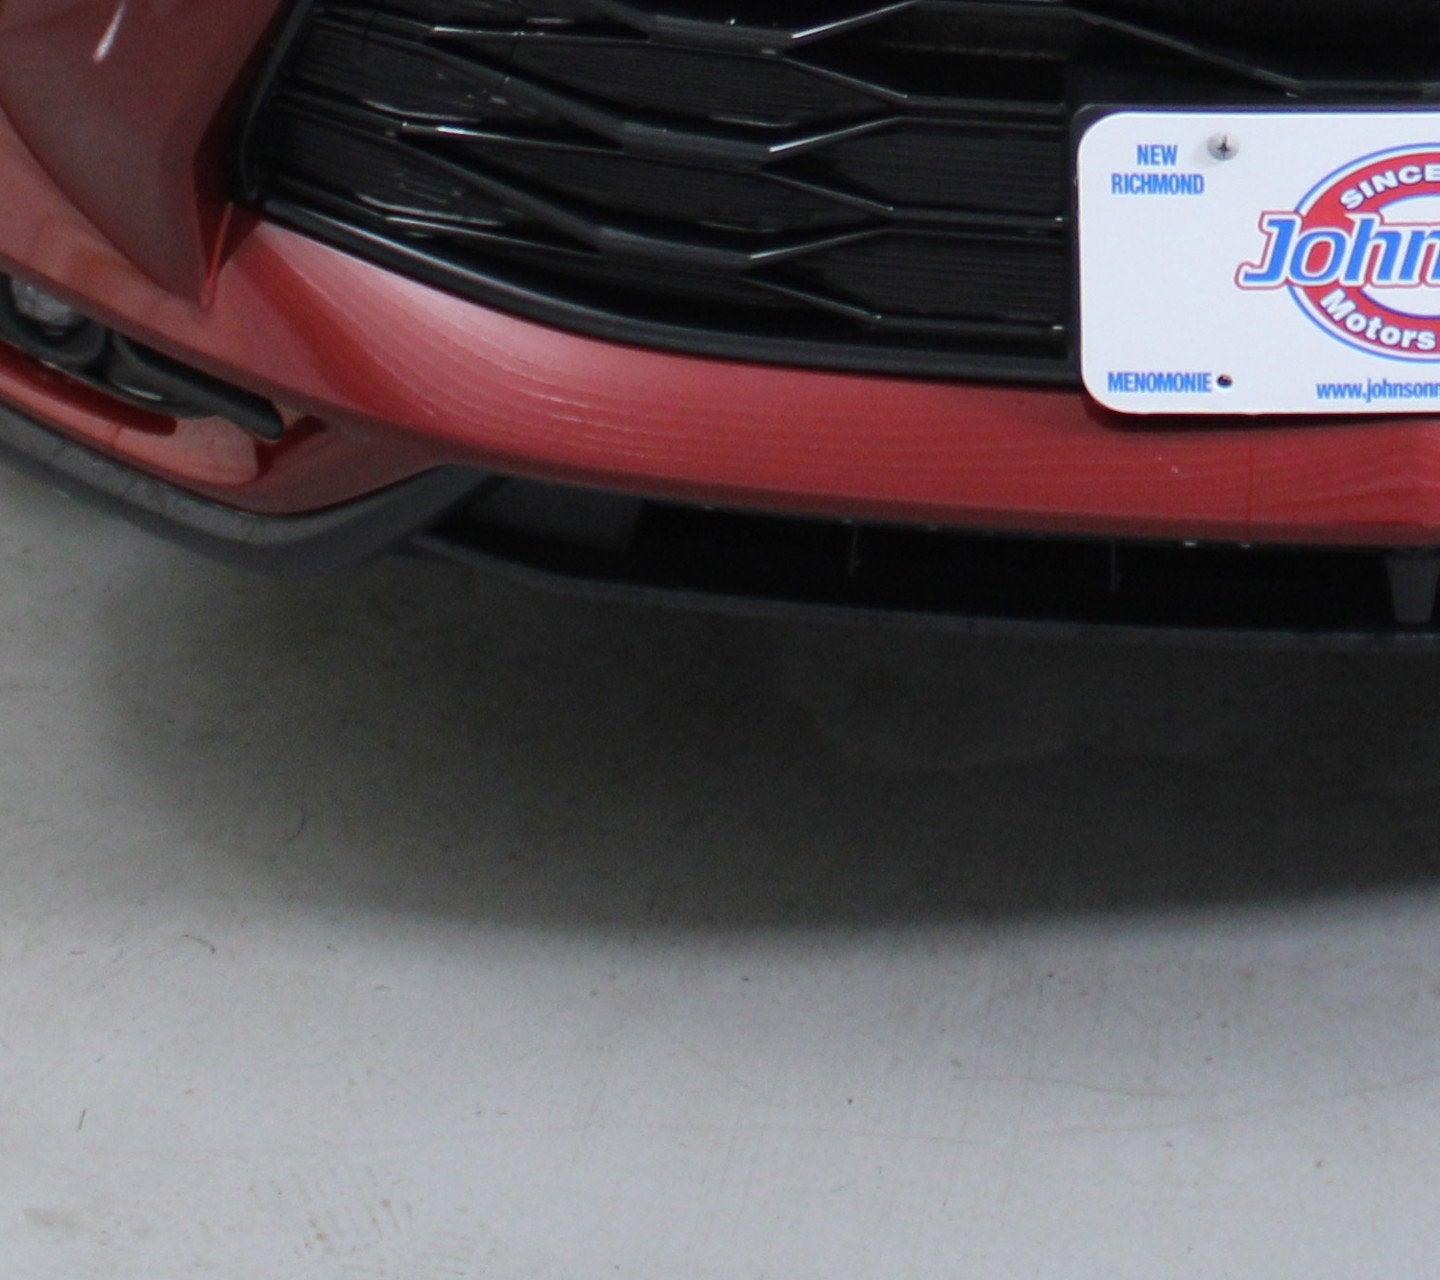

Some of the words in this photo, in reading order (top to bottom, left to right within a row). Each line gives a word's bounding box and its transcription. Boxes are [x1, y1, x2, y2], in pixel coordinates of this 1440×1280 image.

[1137, 144, 1178, 166] NEW
[1111, 173, 1205, 195] RICHMOND
[1319, 287, 1436, 350] Motors
[1107, 372, 1212, 393] MENOMONIE
